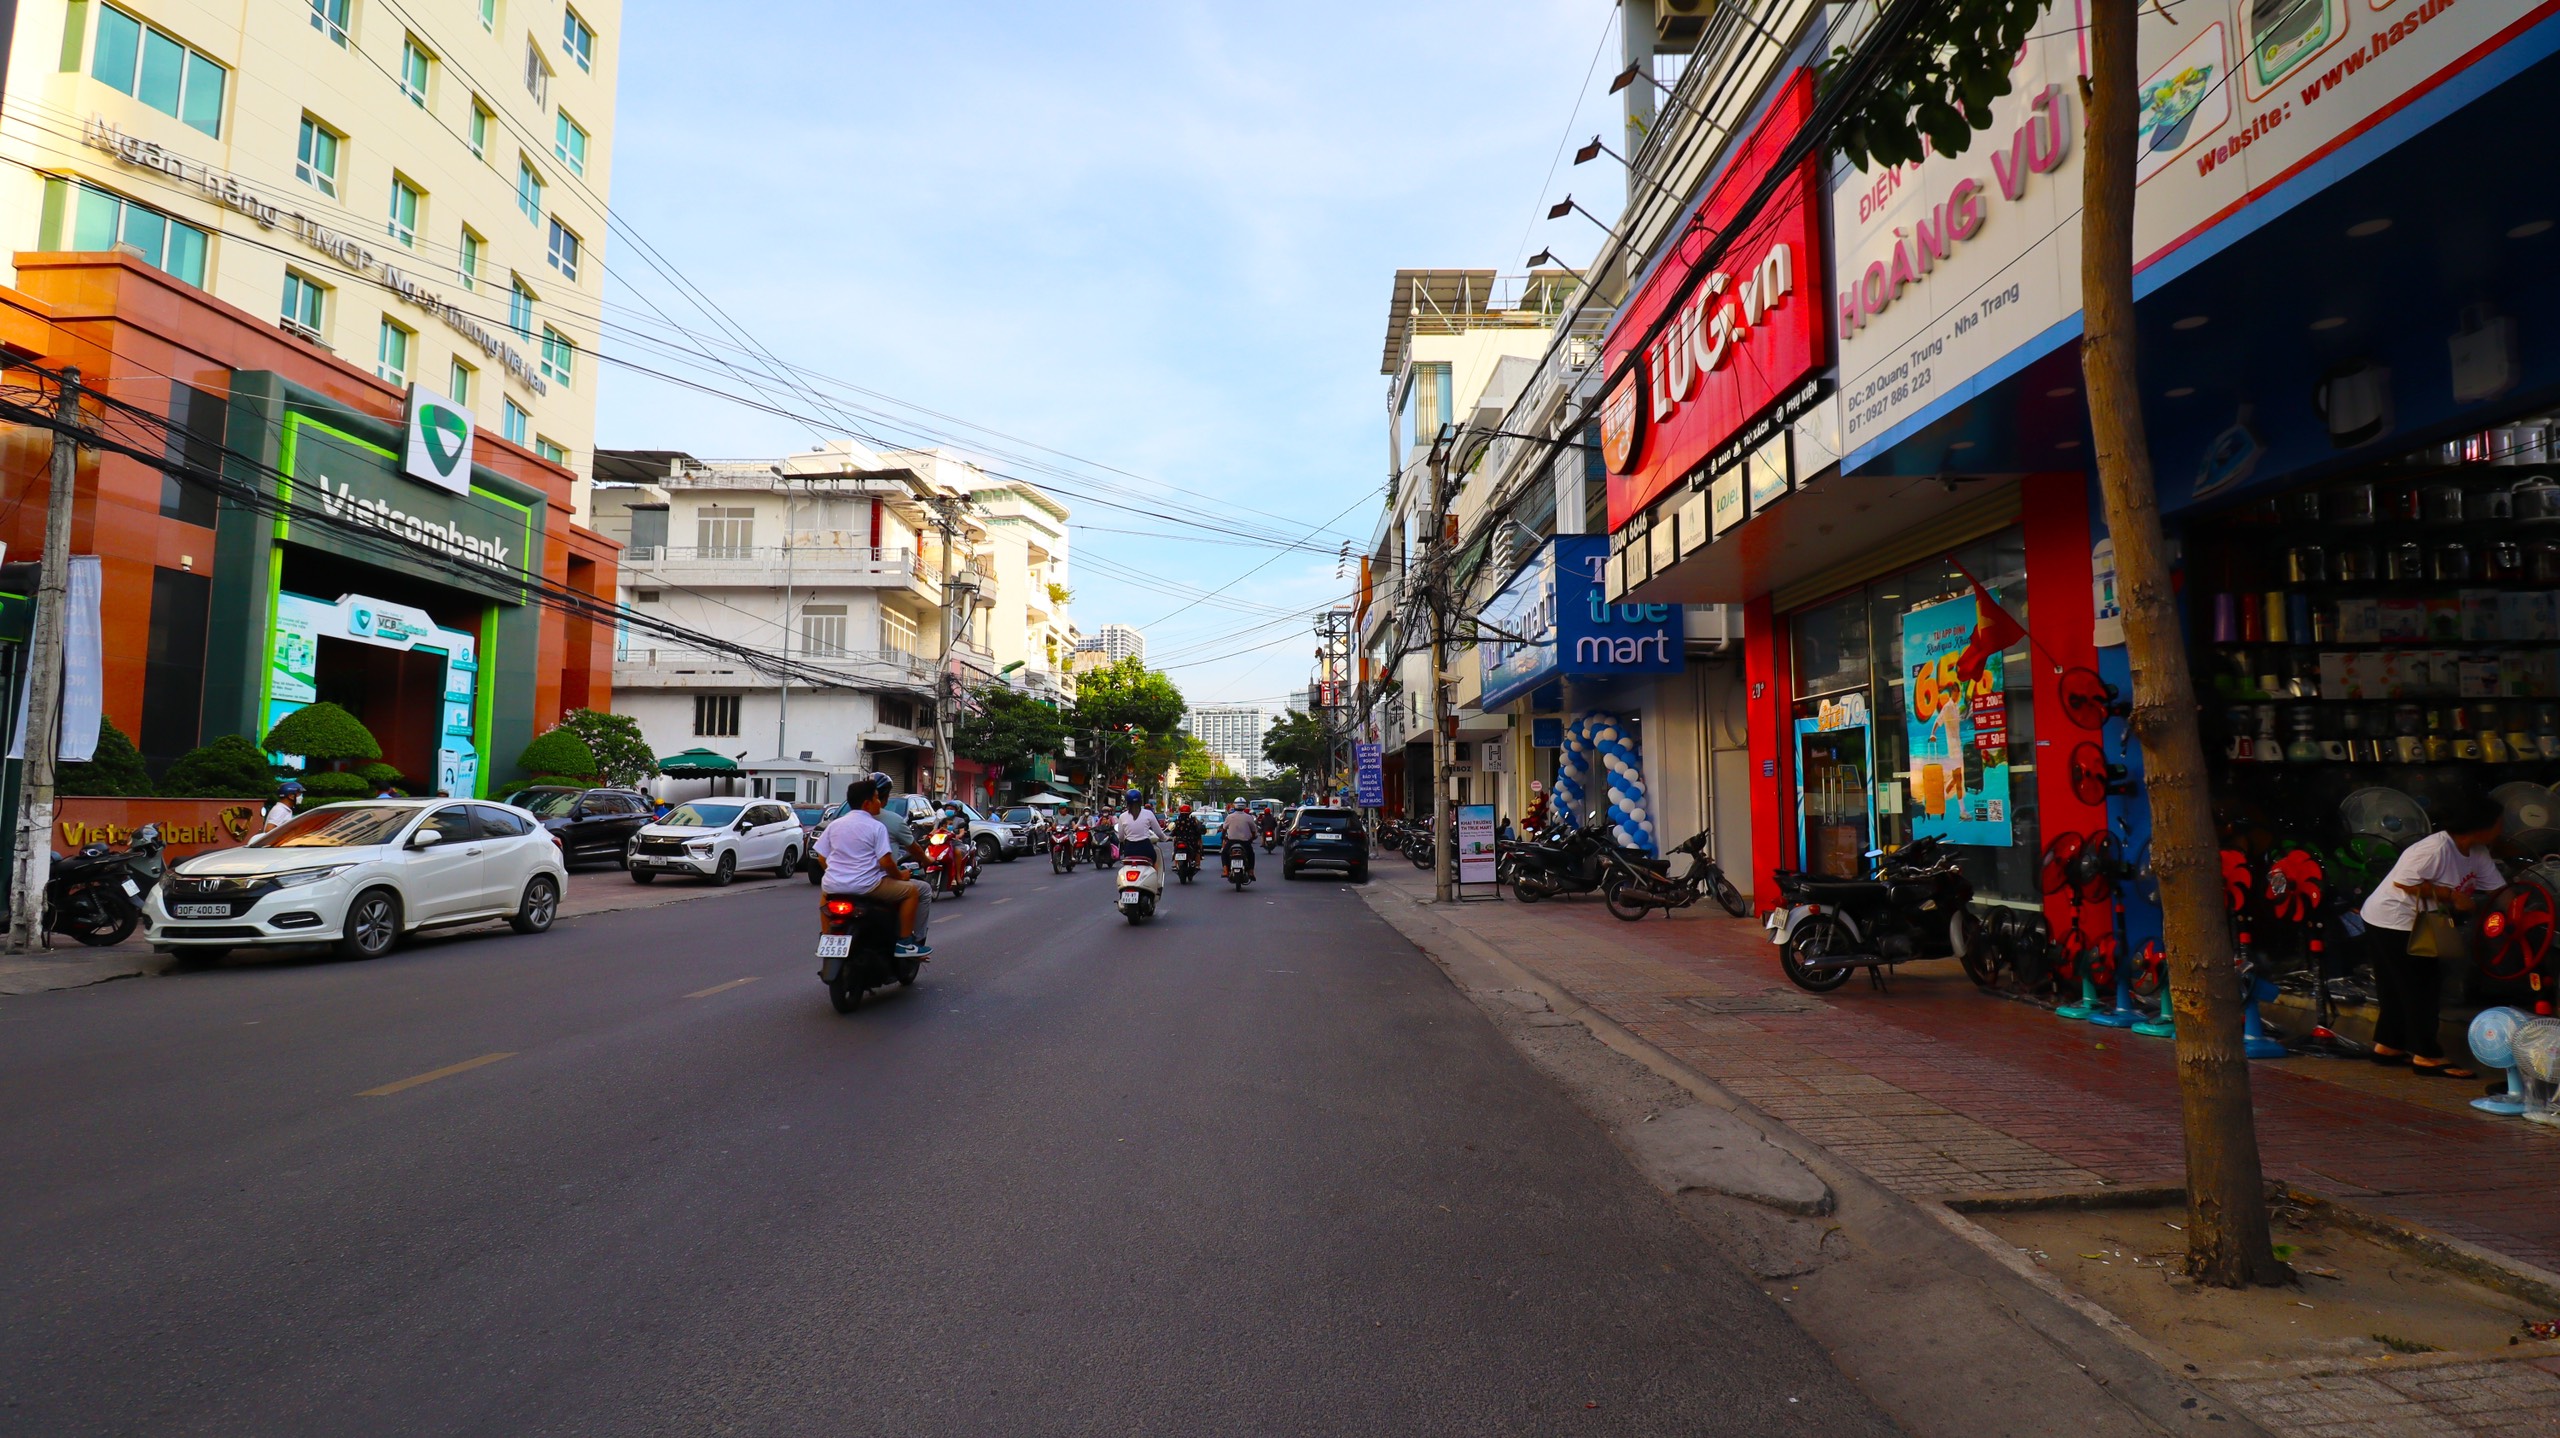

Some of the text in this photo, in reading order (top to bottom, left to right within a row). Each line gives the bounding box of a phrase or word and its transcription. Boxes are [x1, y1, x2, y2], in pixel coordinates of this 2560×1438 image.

[2196, 101, 2291, 177] Website:
[82, 111, 187, 182] Ngân
[201, 166, 280, 231] hàng
[293, 211, 375, 271] TMCP
[1839, 84, 2068, 339] HOÀNG VŨ
[1877, 361, 1909, 392] Quang
[1911, 337, 1943, 367] Trung
[1955, 312, 1978, 338] Nha
[1981, 283, 2019, 318] Trang
[1891, 383, 1909, 406] 886
[1912, 367, 1931, 394] 223
[319, 474, 510, 572] Vietcombank
[1585, 556, 1606, 583] T
[1577, 629, 1670, 664] mart
[61, 821, 220, 847] Vietcbank
[178, 905, 227, 914] 30F-400.50
